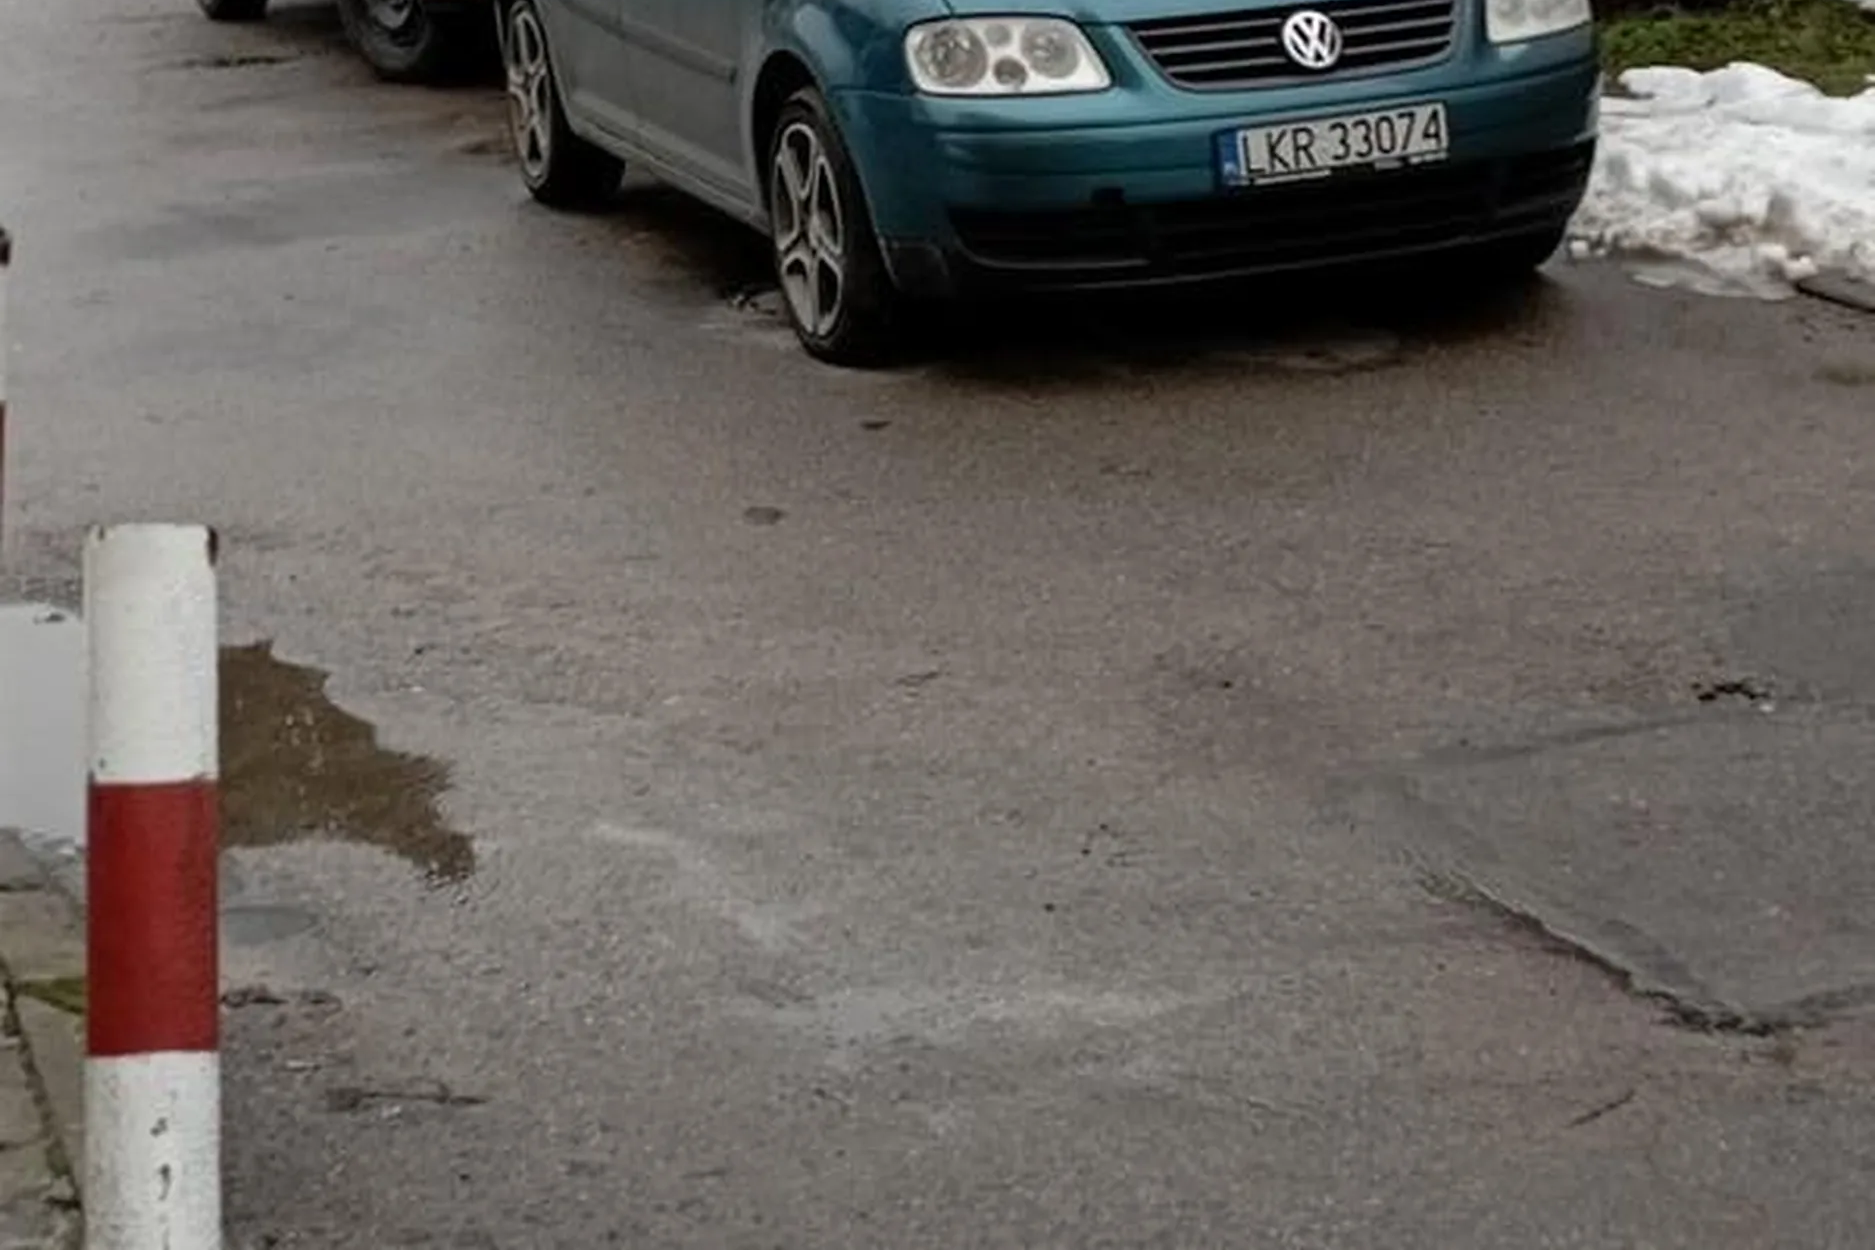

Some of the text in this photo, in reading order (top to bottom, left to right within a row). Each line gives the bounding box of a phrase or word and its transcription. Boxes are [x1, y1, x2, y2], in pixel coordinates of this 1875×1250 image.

[1283, 11, 1341, 68] VW
[1241, 108, 1443, 175] LKR 33074
